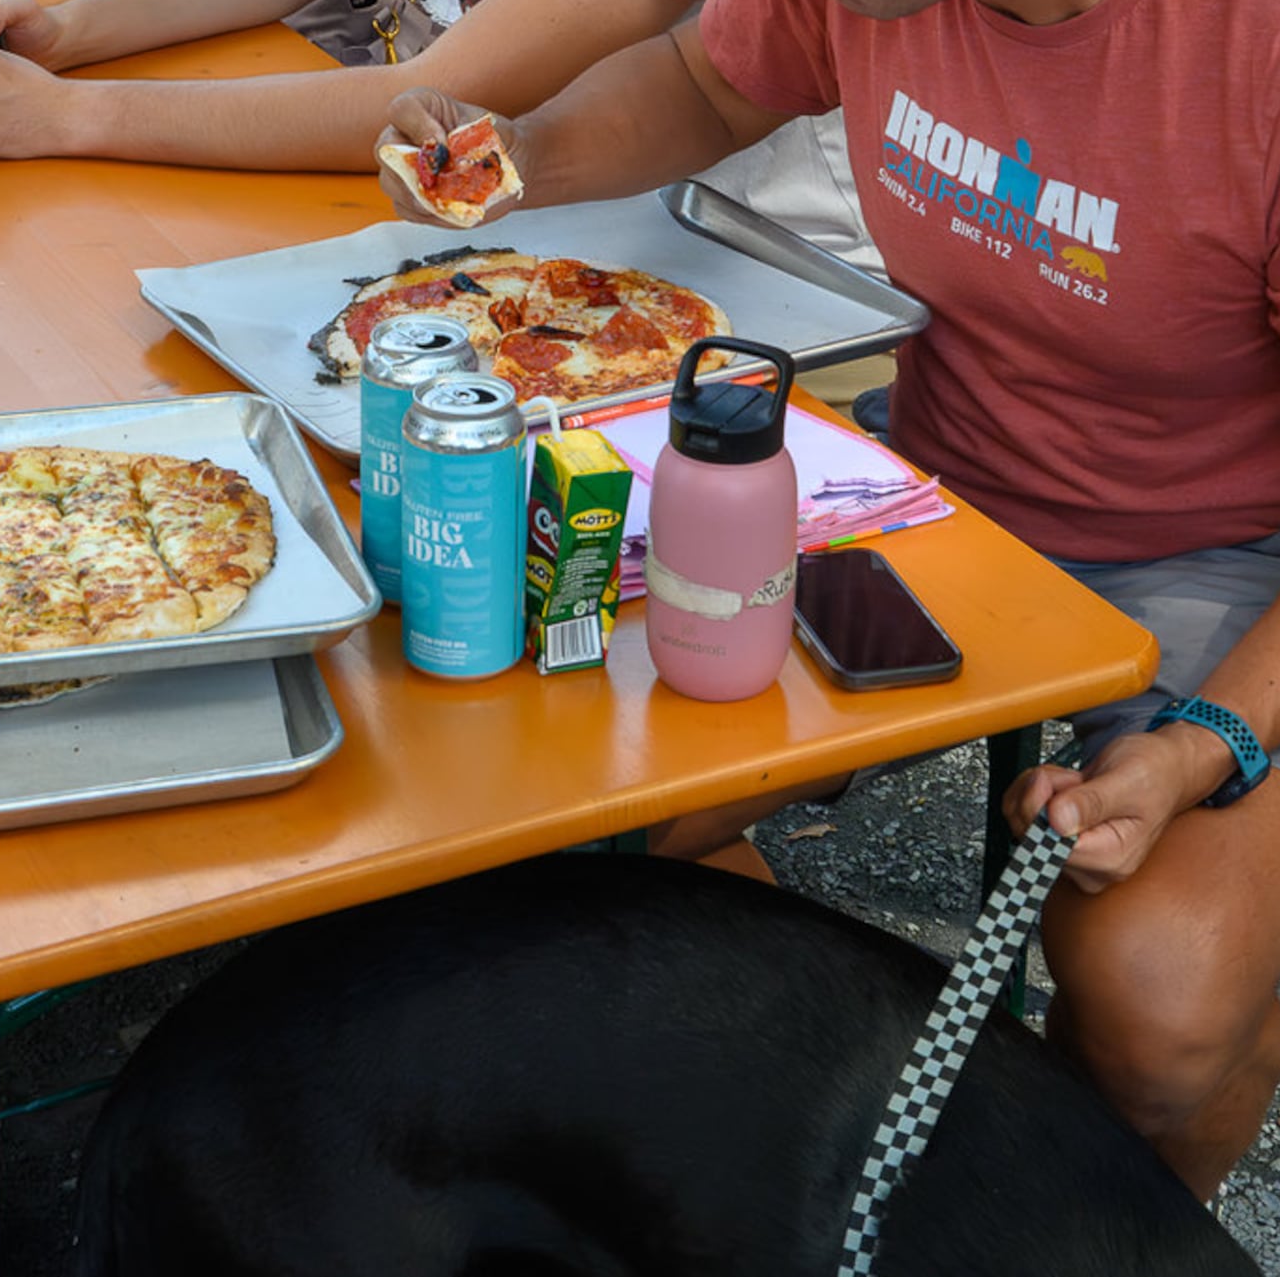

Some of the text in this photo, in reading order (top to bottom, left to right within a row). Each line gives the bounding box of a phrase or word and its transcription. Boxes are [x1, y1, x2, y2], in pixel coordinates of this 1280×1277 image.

[877, 167, 927, 217] SWIM 2.4
[884, 89, 1119, 252] IRONMAN
[882, 141, 1055, 261] CALIFORNIA
[950, 216, 1013, 260] BIKE 112
[1039, 263, 1109, 306] RUN 26.2
[372, 470, 401, 496] ID
[408, 533, 474, 569] IDEA
[414, 514, 464, 545] BIG
